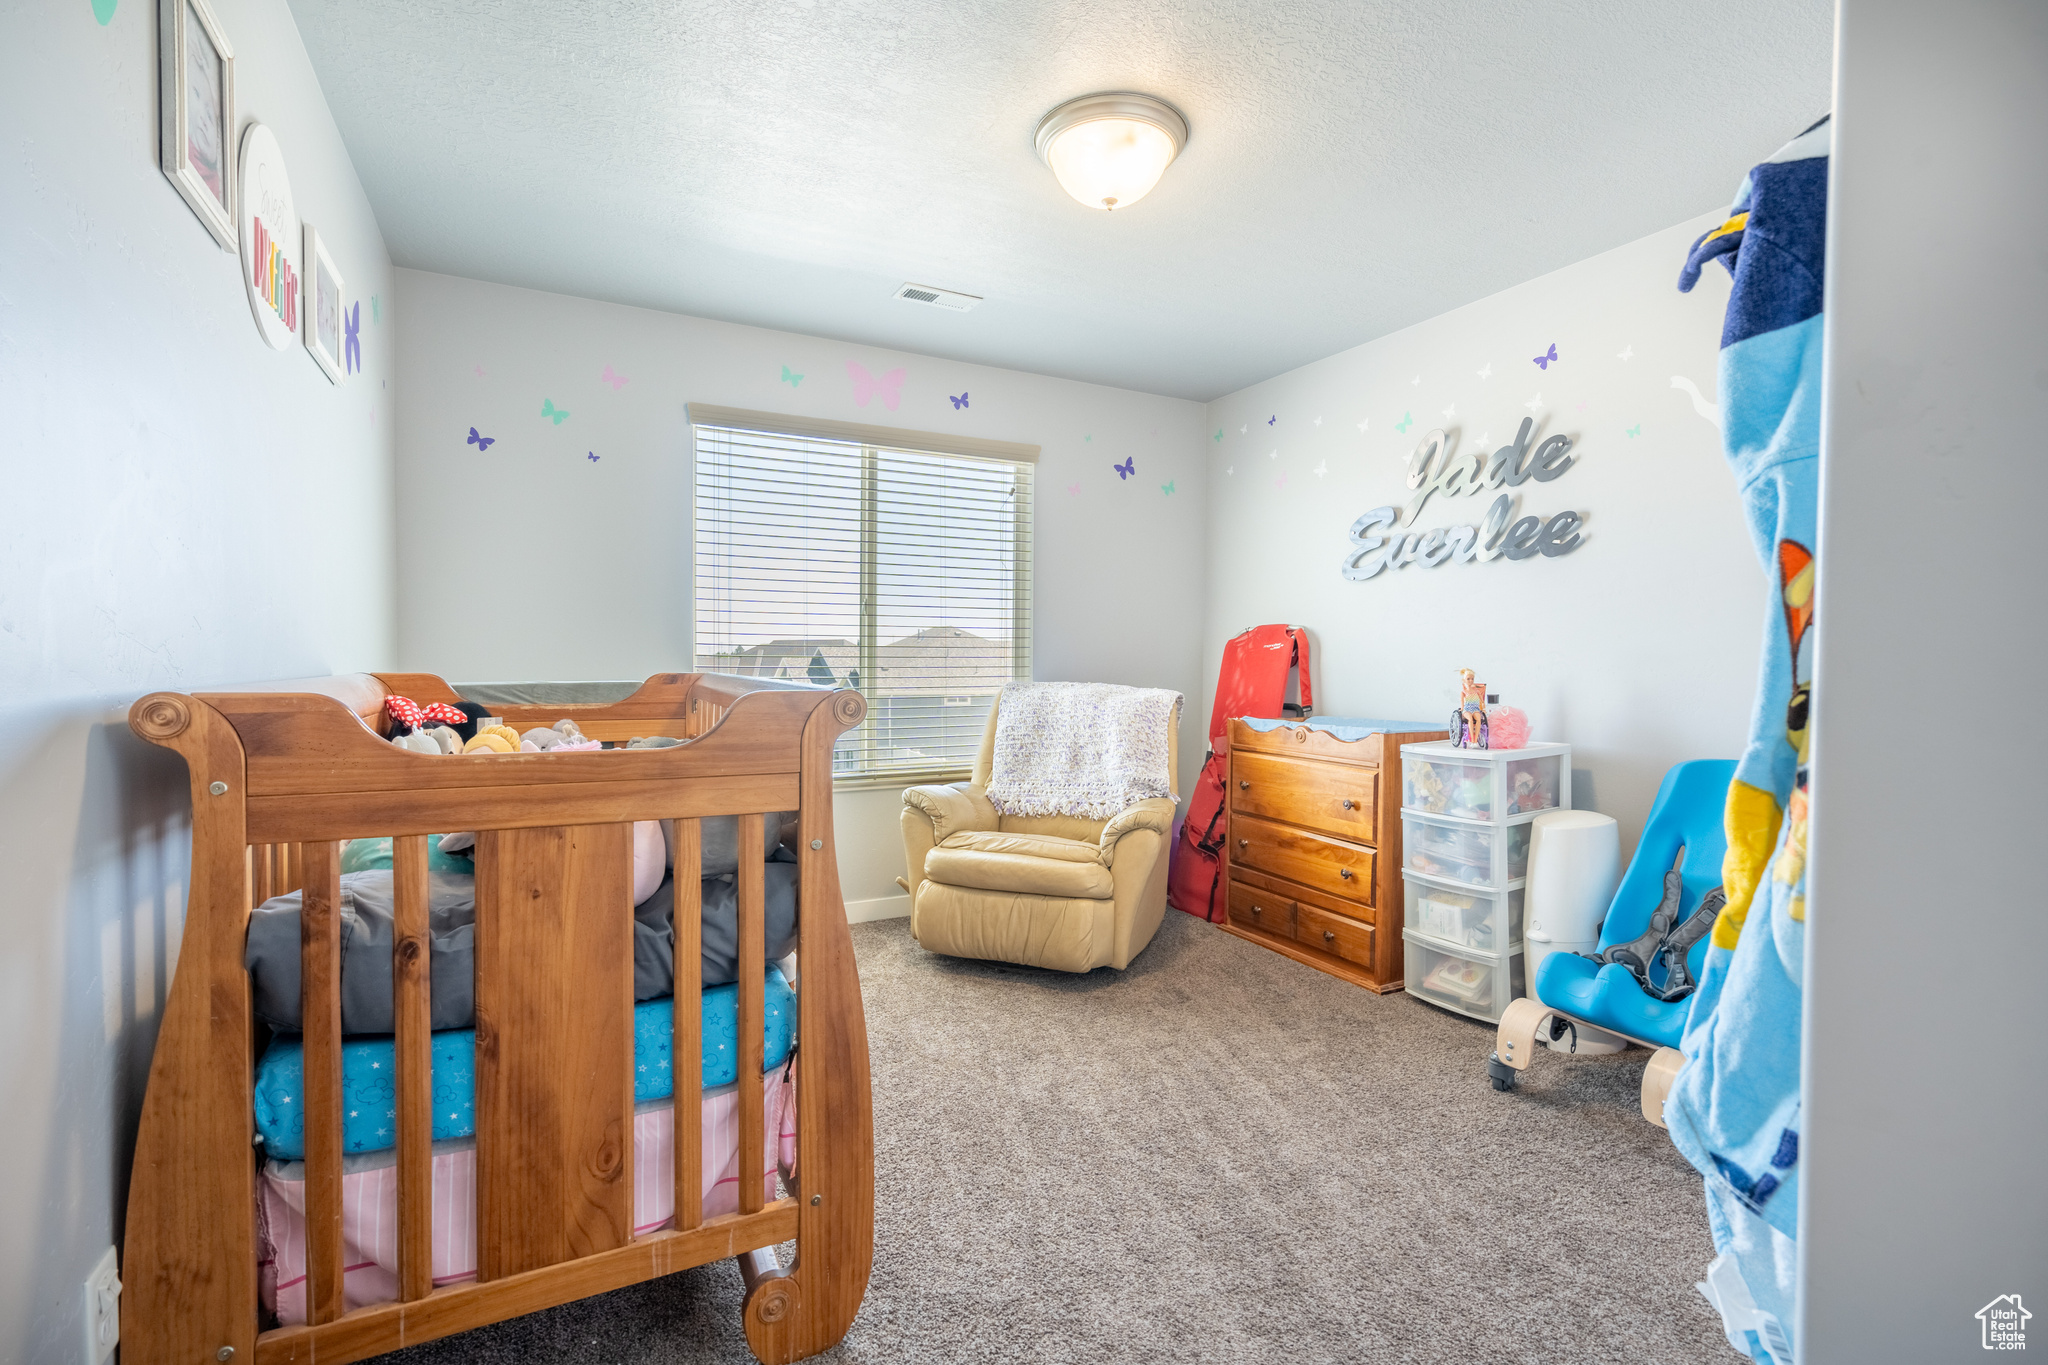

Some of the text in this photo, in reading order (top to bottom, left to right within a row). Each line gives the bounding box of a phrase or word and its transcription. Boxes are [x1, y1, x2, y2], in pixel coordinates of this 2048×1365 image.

[258, 162, 288, 243] Sweet
[254, 216, 298, 333] DREAMS
[1400, 416, 1573, 529] Jade
[1341, 493, 1581, 581] Everlee
